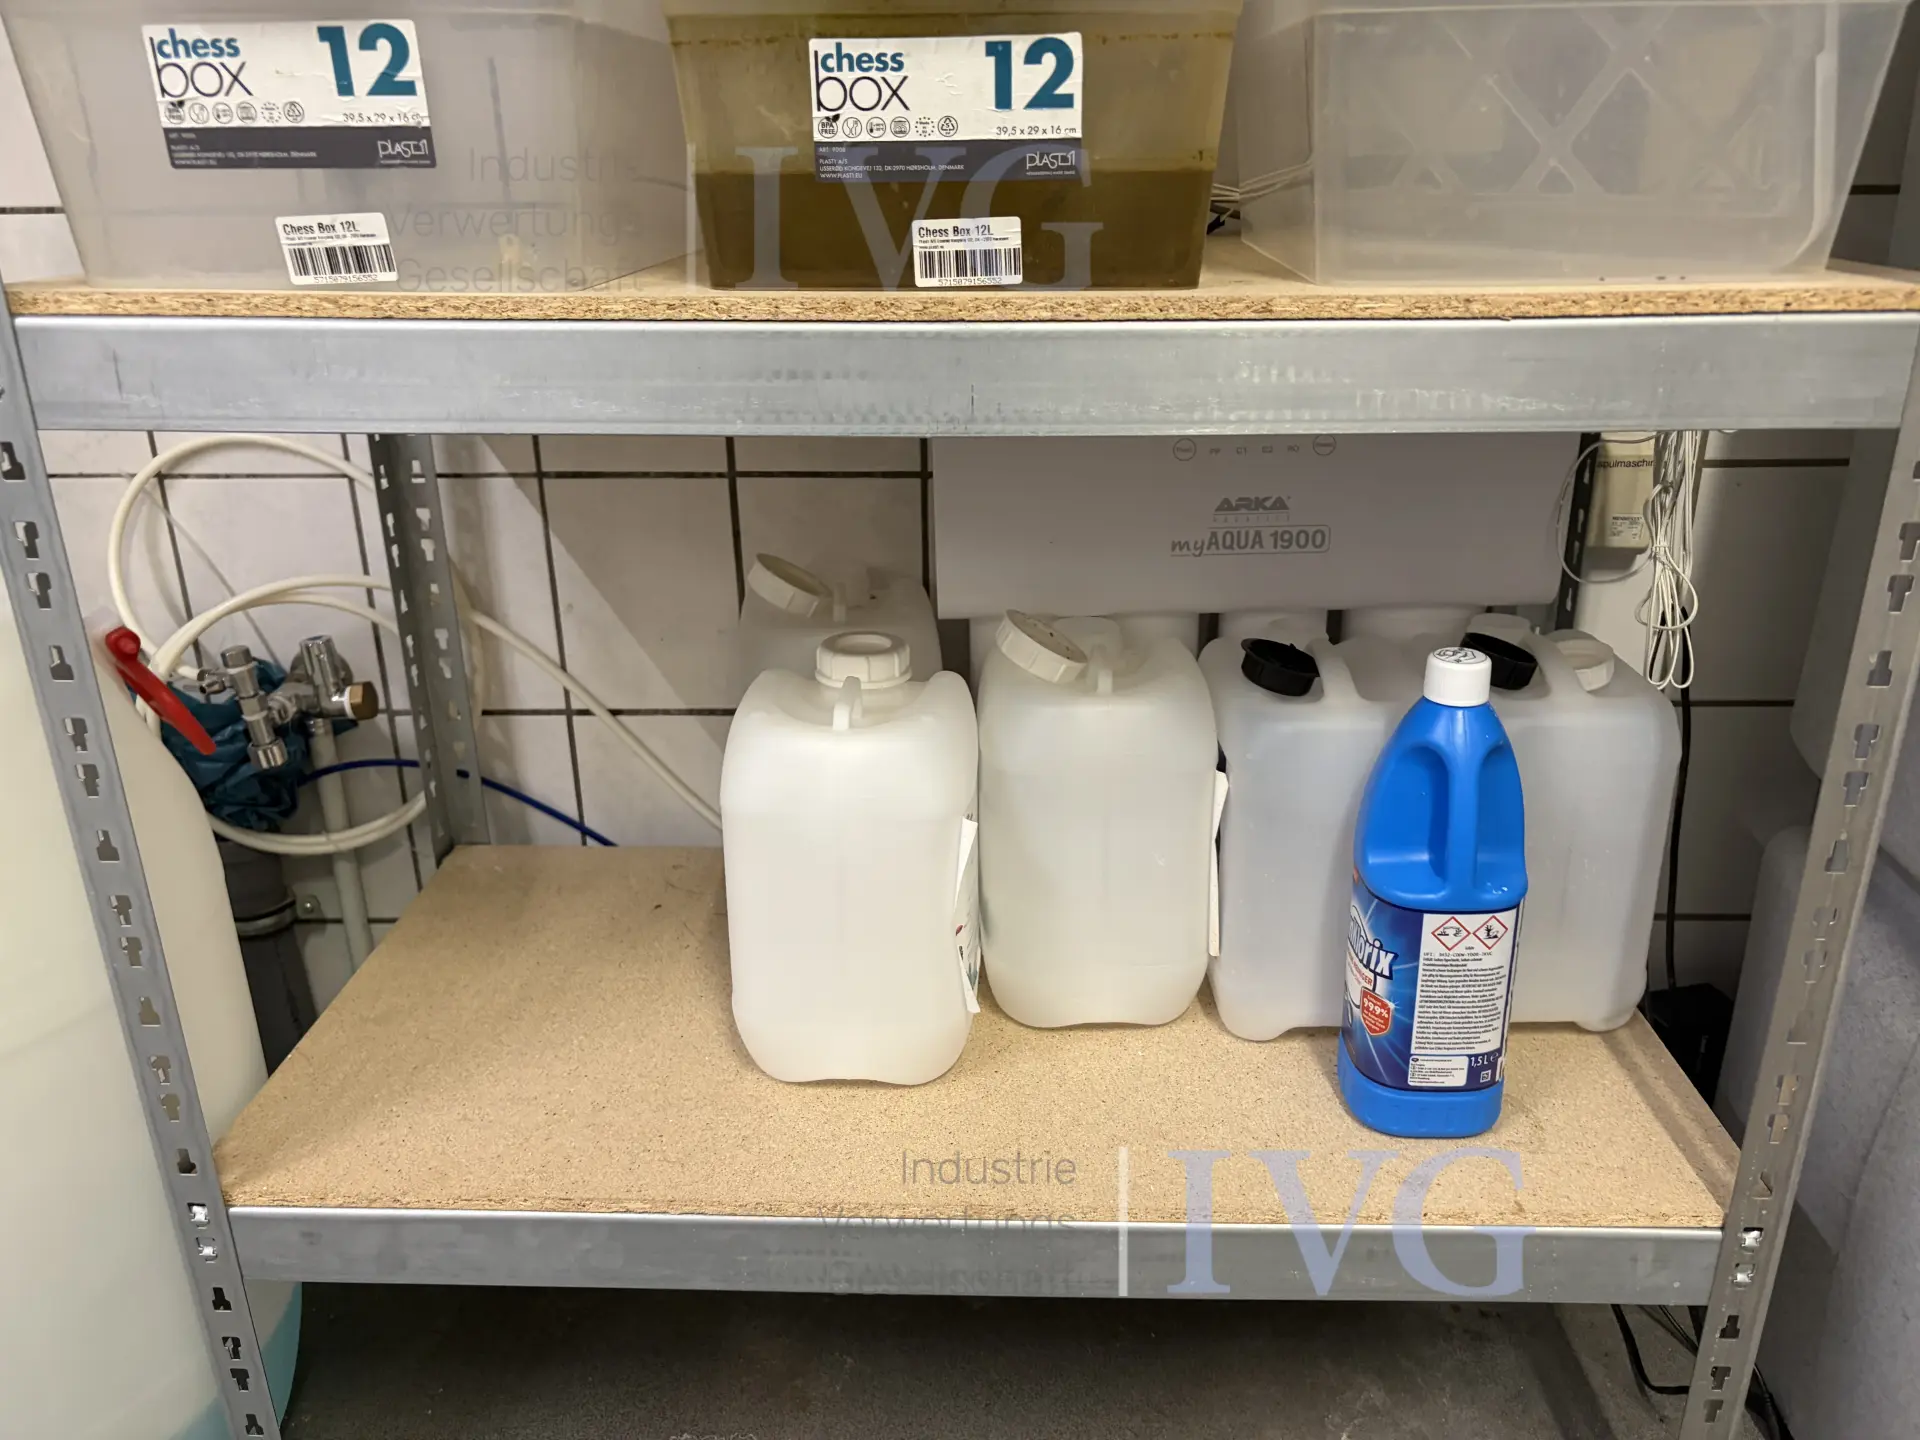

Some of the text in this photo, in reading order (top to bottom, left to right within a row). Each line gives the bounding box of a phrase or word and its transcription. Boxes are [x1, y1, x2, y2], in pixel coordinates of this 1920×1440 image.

[157, 28, 240, 59] chess
[149, 36, 254, 98] box
[316, 22, 417, 96] 12
[820, 42, 905, 73] chess
[814, 50, 910, 112] box
[985, 37, 1075, 110] 12
[821, 121, 834, 129] BPA
[996, 126, 1017, 137] 39,5
[1027, 126, 1040, 135] 29
[1050, 125, 1062, 135] 16
[282, 220, 361, 235] Chess Box 12L
[918, 224, 994, 238] Chess Box 12L
[1214, 496, 1291, 511] ARKA
[1269, 528, 1327, 550] 1900
[1470, 1056, 1482, 1067] 1,5
